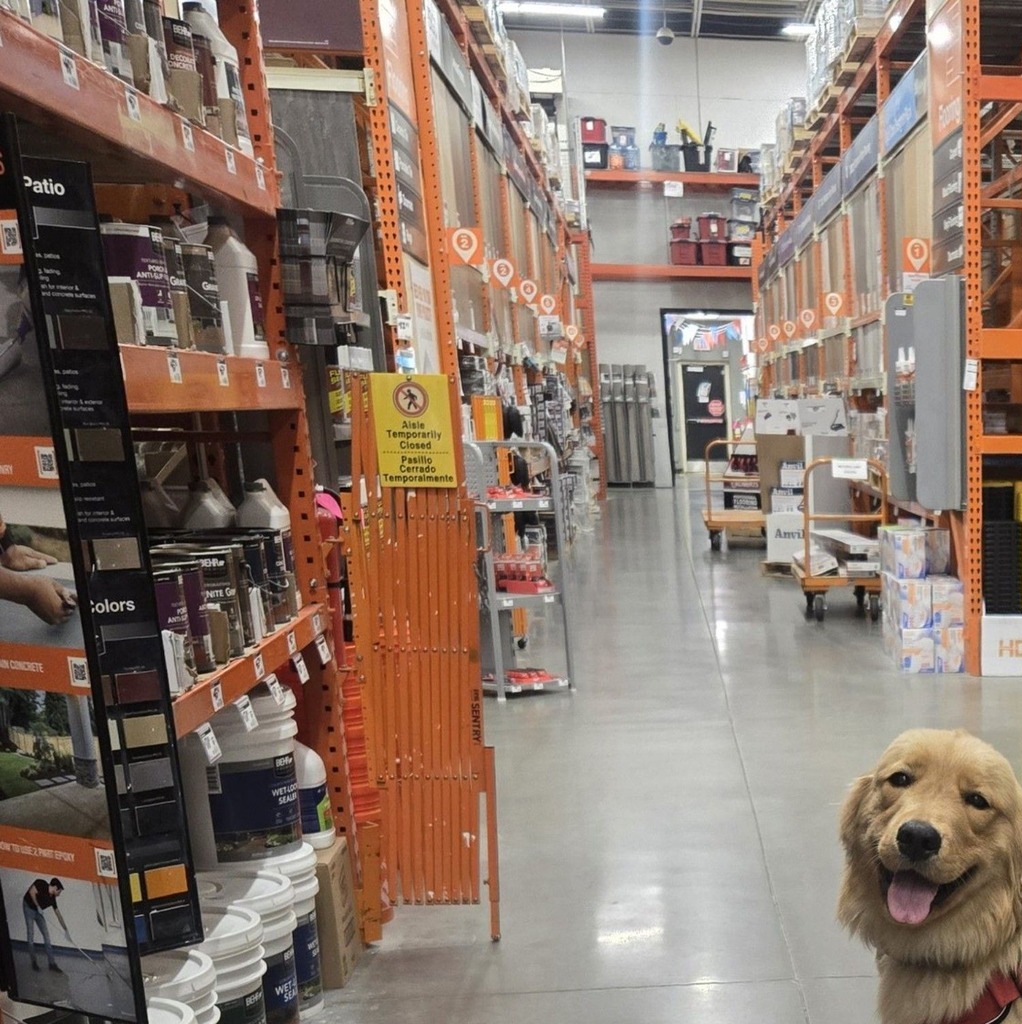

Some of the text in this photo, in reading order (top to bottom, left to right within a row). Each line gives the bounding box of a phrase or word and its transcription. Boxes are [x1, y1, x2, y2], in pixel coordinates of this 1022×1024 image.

[401, 420, 426, 430] Aisle
[386, 429, 442, 441] Temporarily
[399, 441, 432, 450] Closed
[401, 455, 433, 465] Pasillo
[399, 464, 437, 474] Cerrado
[383, 473, 454, 484] Temporalmente
